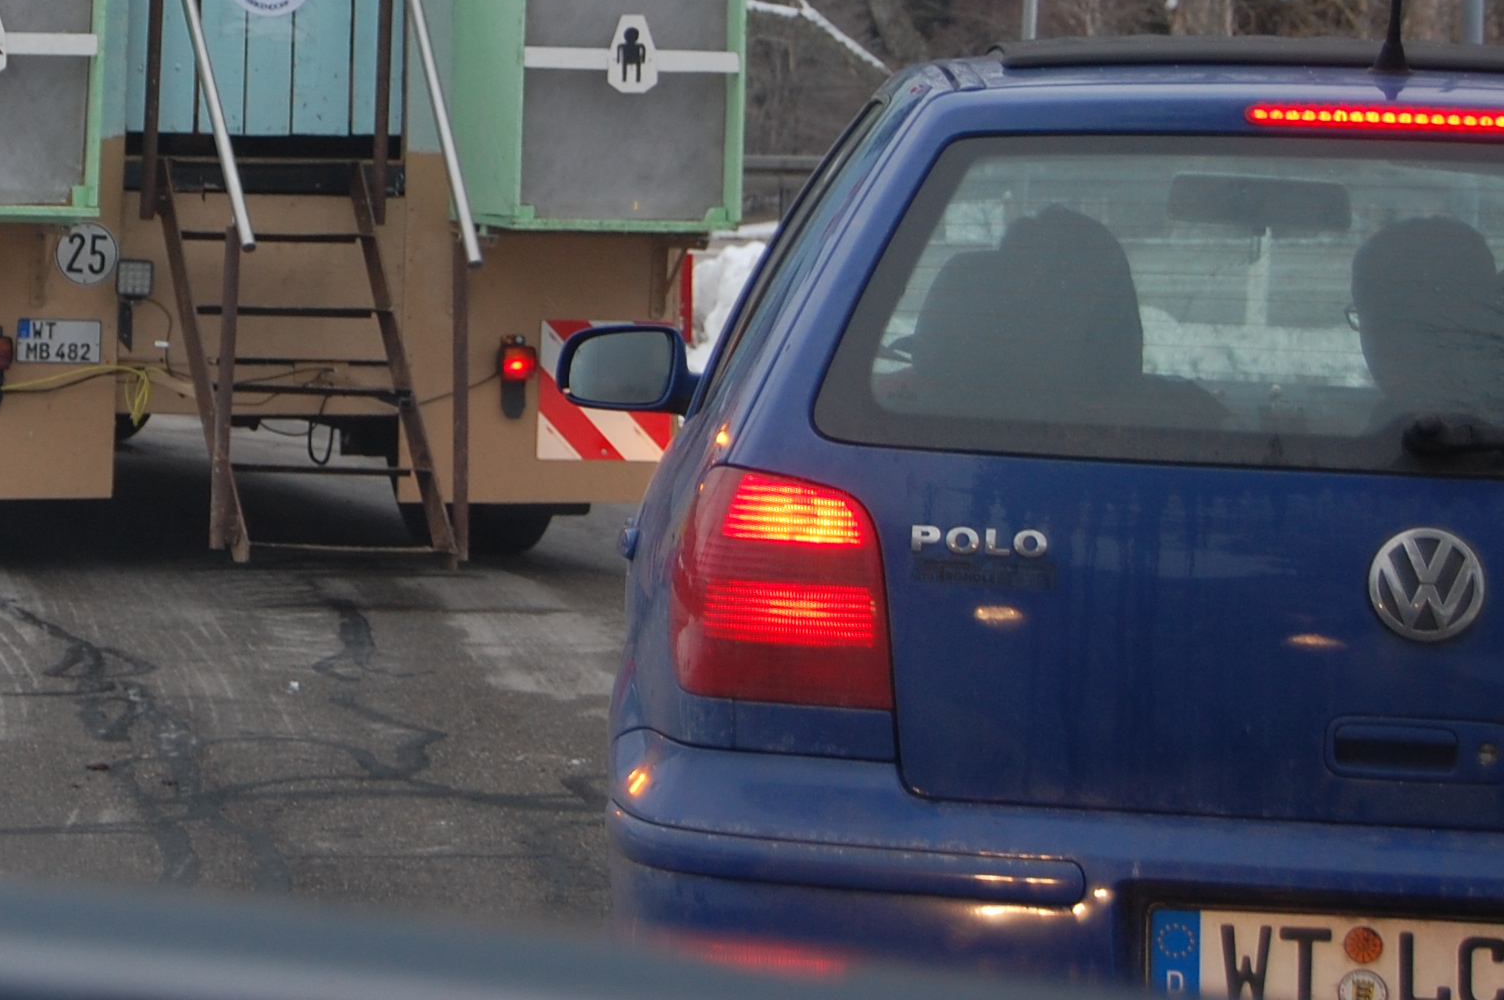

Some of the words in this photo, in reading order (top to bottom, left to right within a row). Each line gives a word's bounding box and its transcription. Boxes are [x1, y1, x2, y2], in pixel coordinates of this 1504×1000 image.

[65, 232, 108, 275] 25
[32, 321, 57, 340] WT
[25, 342, 50, 361] MB
[54, 343, 91, 361] 482
[911, 524, 1048, 558] POLO
[1220, 923, 1332, 1000] WT
